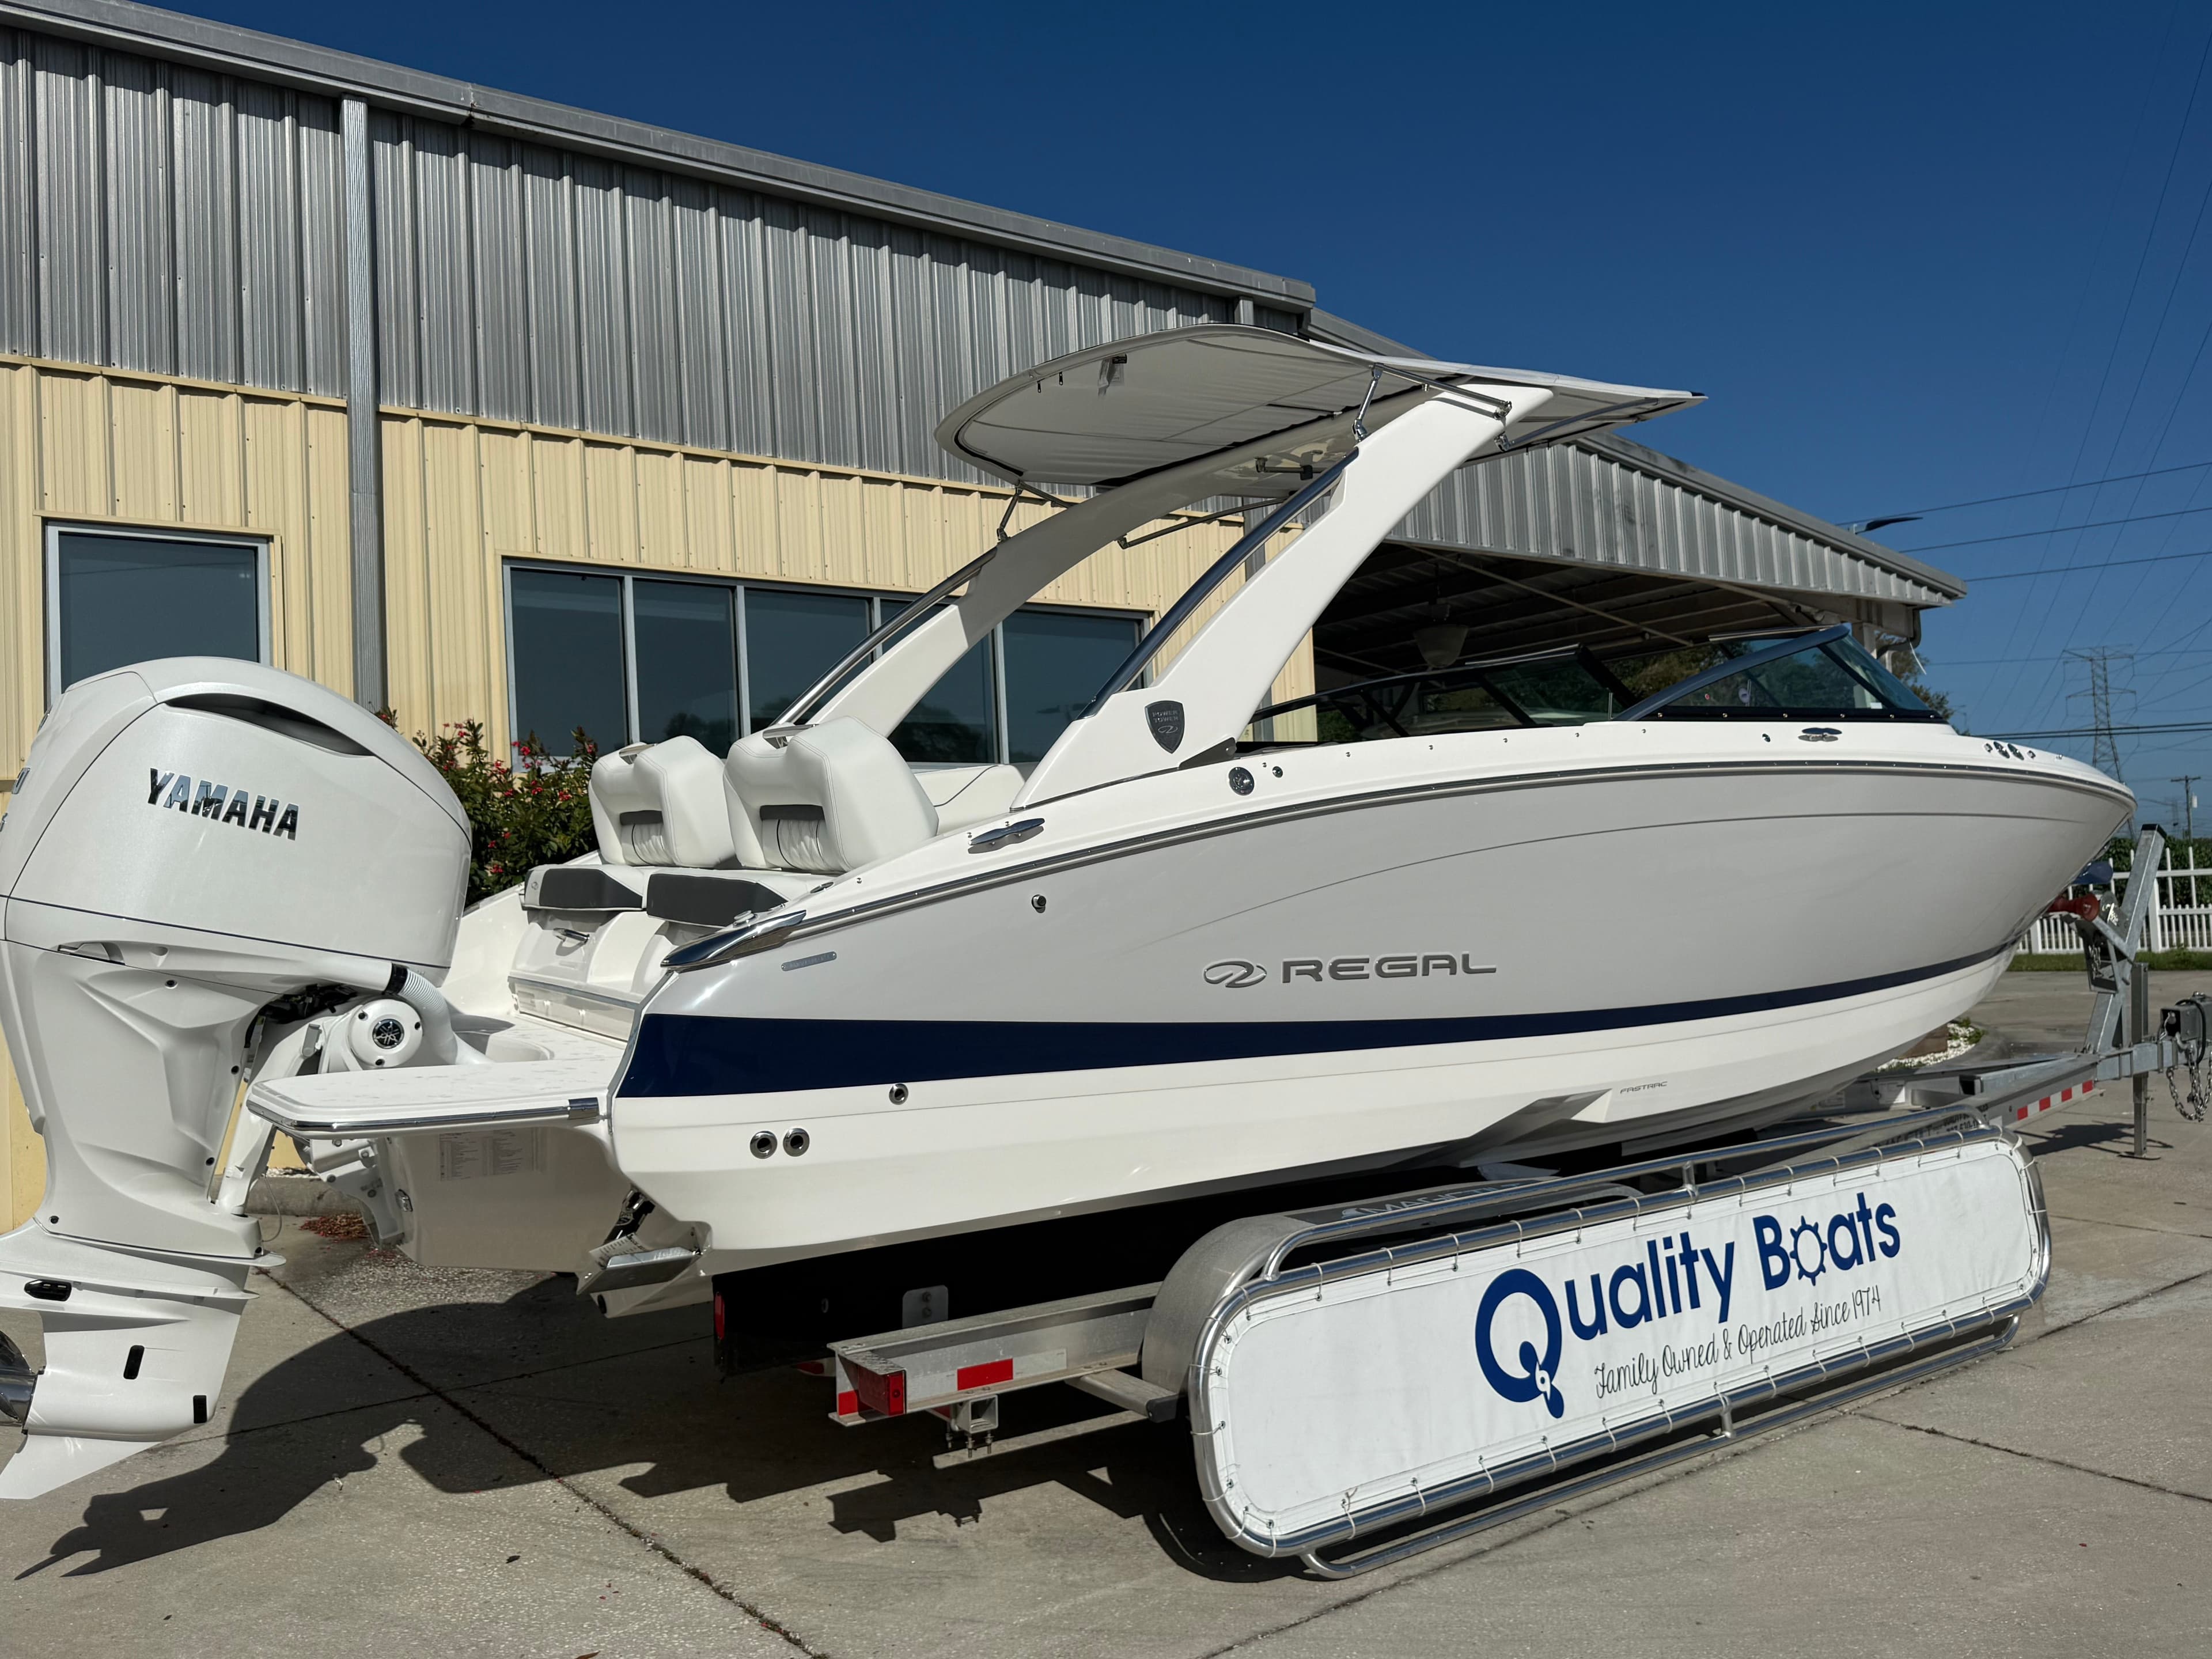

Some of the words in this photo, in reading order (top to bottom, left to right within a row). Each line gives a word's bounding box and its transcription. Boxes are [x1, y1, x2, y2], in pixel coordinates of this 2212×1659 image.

[147, 767, 299, 840] YAMAHA
[1282, 952, 1497, 983] REGAL
[1620, 1081, 1668, 1094] FASTRAC
[1475, 1231, 1735, 1419] Quality
[1752, 1192, 1900, 1291] Boats
[1594, 1353, 1658, 1399] Family
[1662, 1332, 1719, 1377] Owned
[1722, 1328, 1732, 1360] &
[1737, 1306, 1807, 1365] Operated
[1810, 1301, 1850, 1335] Since
[1851, 1285, 1881, 1320] 1974
